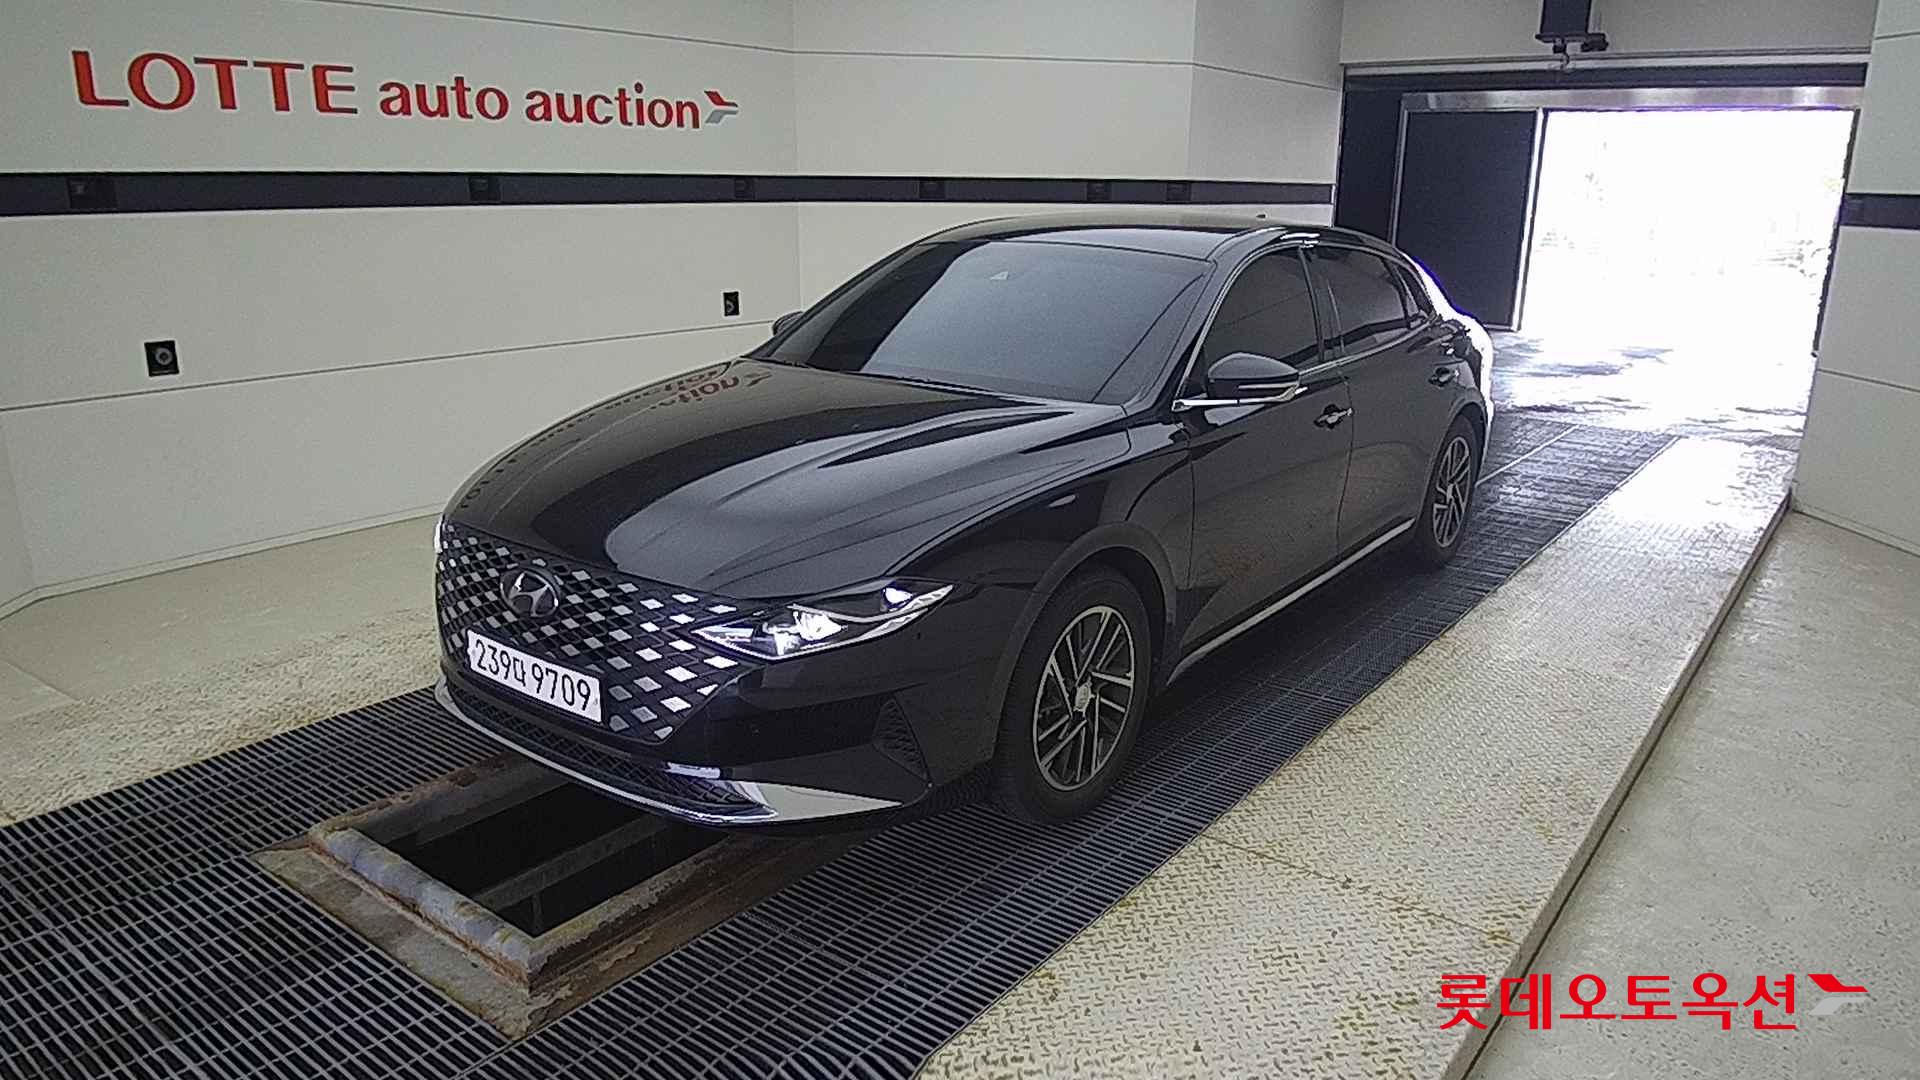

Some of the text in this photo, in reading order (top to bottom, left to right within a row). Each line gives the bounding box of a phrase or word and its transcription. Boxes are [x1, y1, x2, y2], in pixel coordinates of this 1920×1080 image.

[72, 50, 701, 129] LOTTE auto auction
[531, 662, 591, 711] 9709
